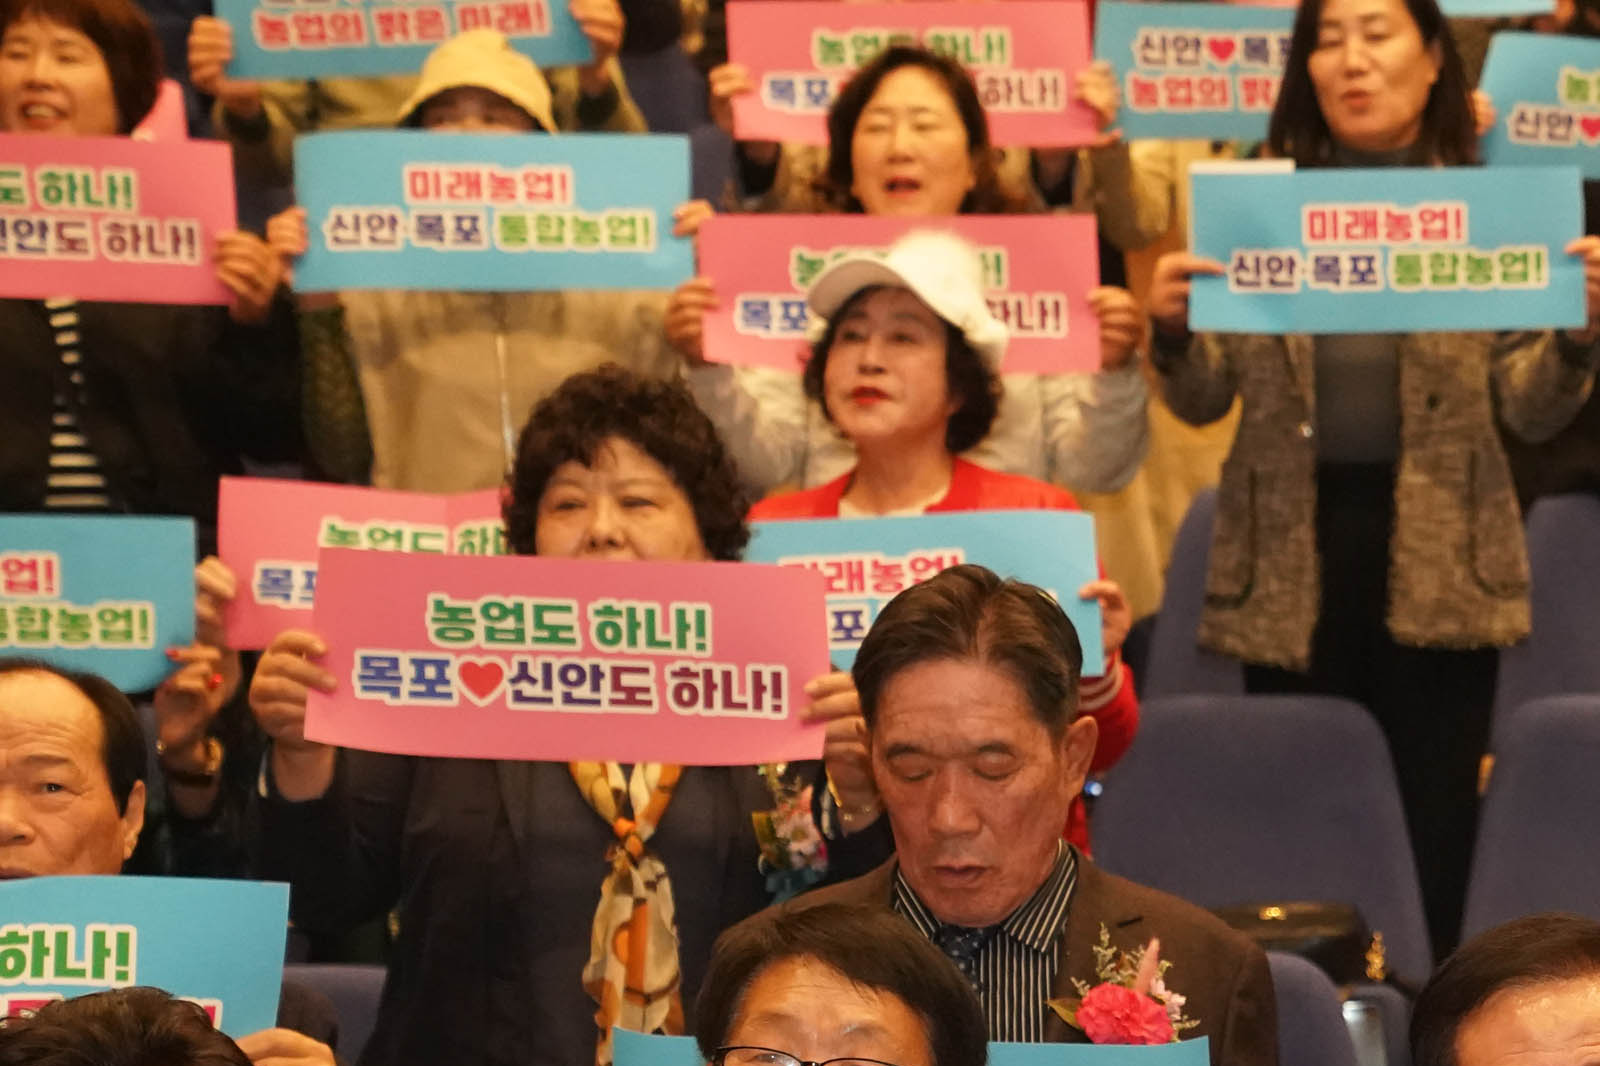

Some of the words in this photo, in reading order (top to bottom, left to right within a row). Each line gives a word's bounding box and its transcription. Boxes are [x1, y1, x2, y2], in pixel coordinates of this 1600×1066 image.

[817, 34, 914, 66] 농업
[1140, 35, 1201, 65] 신안
[1511, 115, 1576, 143] 신안
[40, 171, 133, 209] 하나!
[409, 168, 569, 202] 미래농업!
[0, 217, 90, 254] 안도
[104, 222, 196, 261] 하나!
[501, 211, 653, 248] 통합농업!
[1307, 208, 1464, 242] 미래농업!
[1393, 250, 1545, 286] 통합농업!
[783, 553, 958, 593] 래농업
[0, 605, 148, 642] 합농업!
[429, 599, 578, 646] 농업도
[593, 605, 706, 653] 하나!
[359, 655, 454, 700] 목포
[508, 661, 654, 709] 신안도
[670, 668, 783, 714] 하나!
[0, 930, 130, 982] 하나!
